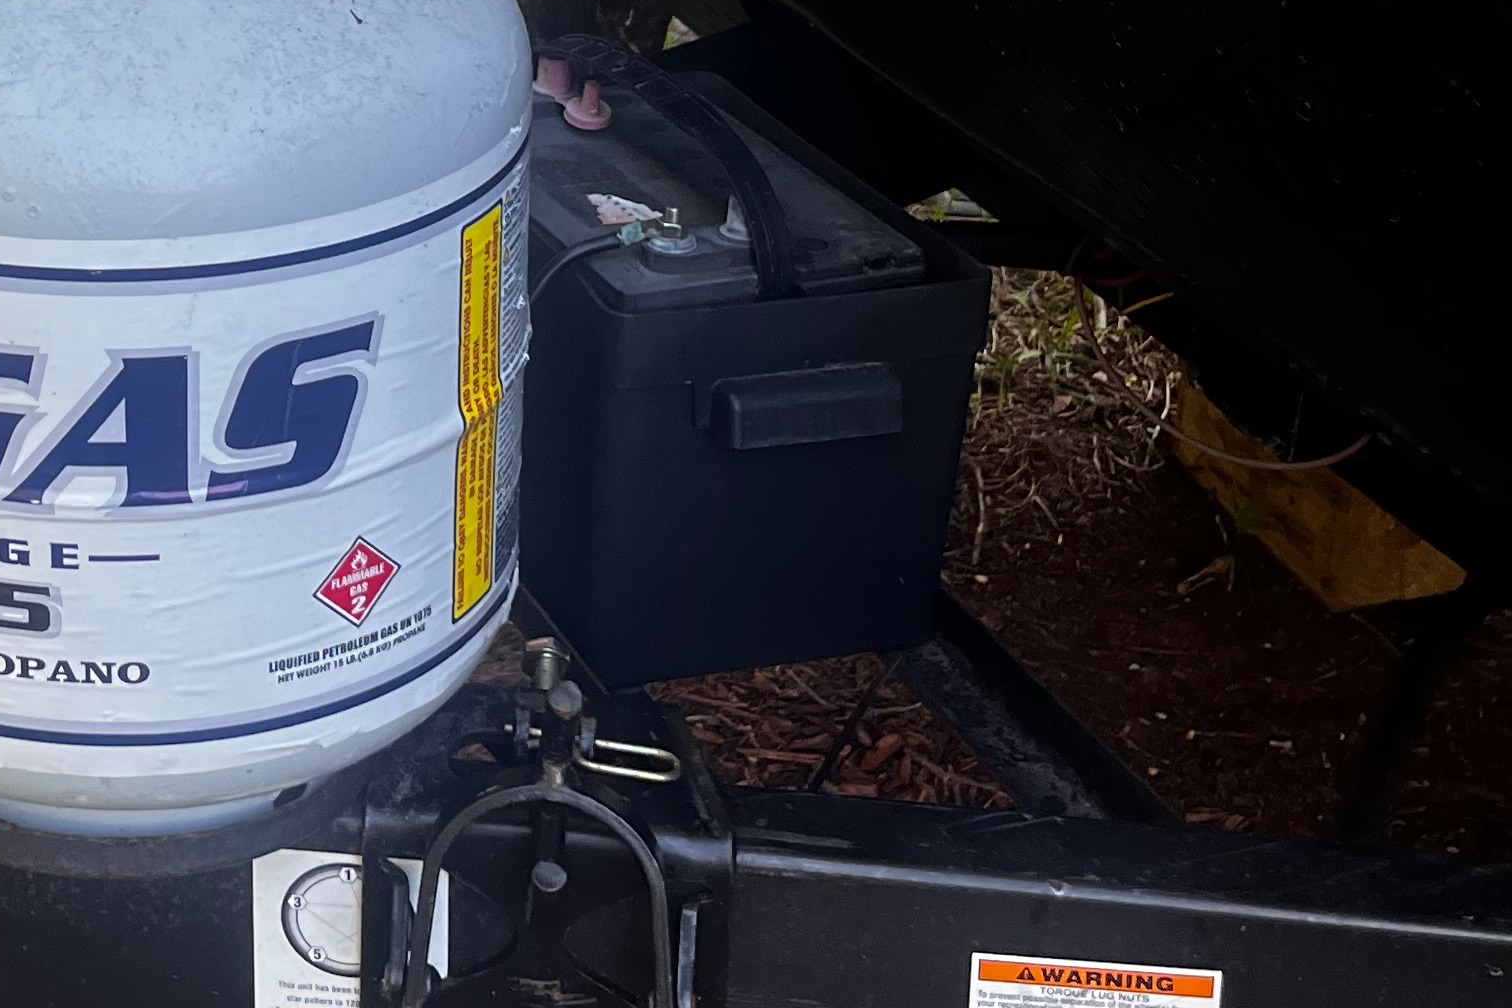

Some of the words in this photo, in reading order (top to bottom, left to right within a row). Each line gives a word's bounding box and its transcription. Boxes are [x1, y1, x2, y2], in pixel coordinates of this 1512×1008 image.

[464, 278, 472, 304] CAN
[463, 389, 474, 414] AND
[331, 562, 385, 590] FLAMMABLE
[349, 581, 369, 597] GAS
[351, 595, 367, 615] 2
[268, 650, 320, 674] LIQUIFIED
[322, 630, 379, 661] PETROLEUM
[380, 622, 399, 639] GAS
[277, 672, 295, 684] NET
[296, 661, 331, 679] WEIGHT
[392, 622, 426, 647] PROPANE
[344, 869, 351, 881] 1
[293, 896, 302, 908] 3
[313, 948, 322, 960] 5
[278, 980, 295, 990] This
[1040, 967, 1175, 993] WARNING
[1039, 986, 1088, 998] TORQUE
[1091, 990, 1115, 1000] LUG
